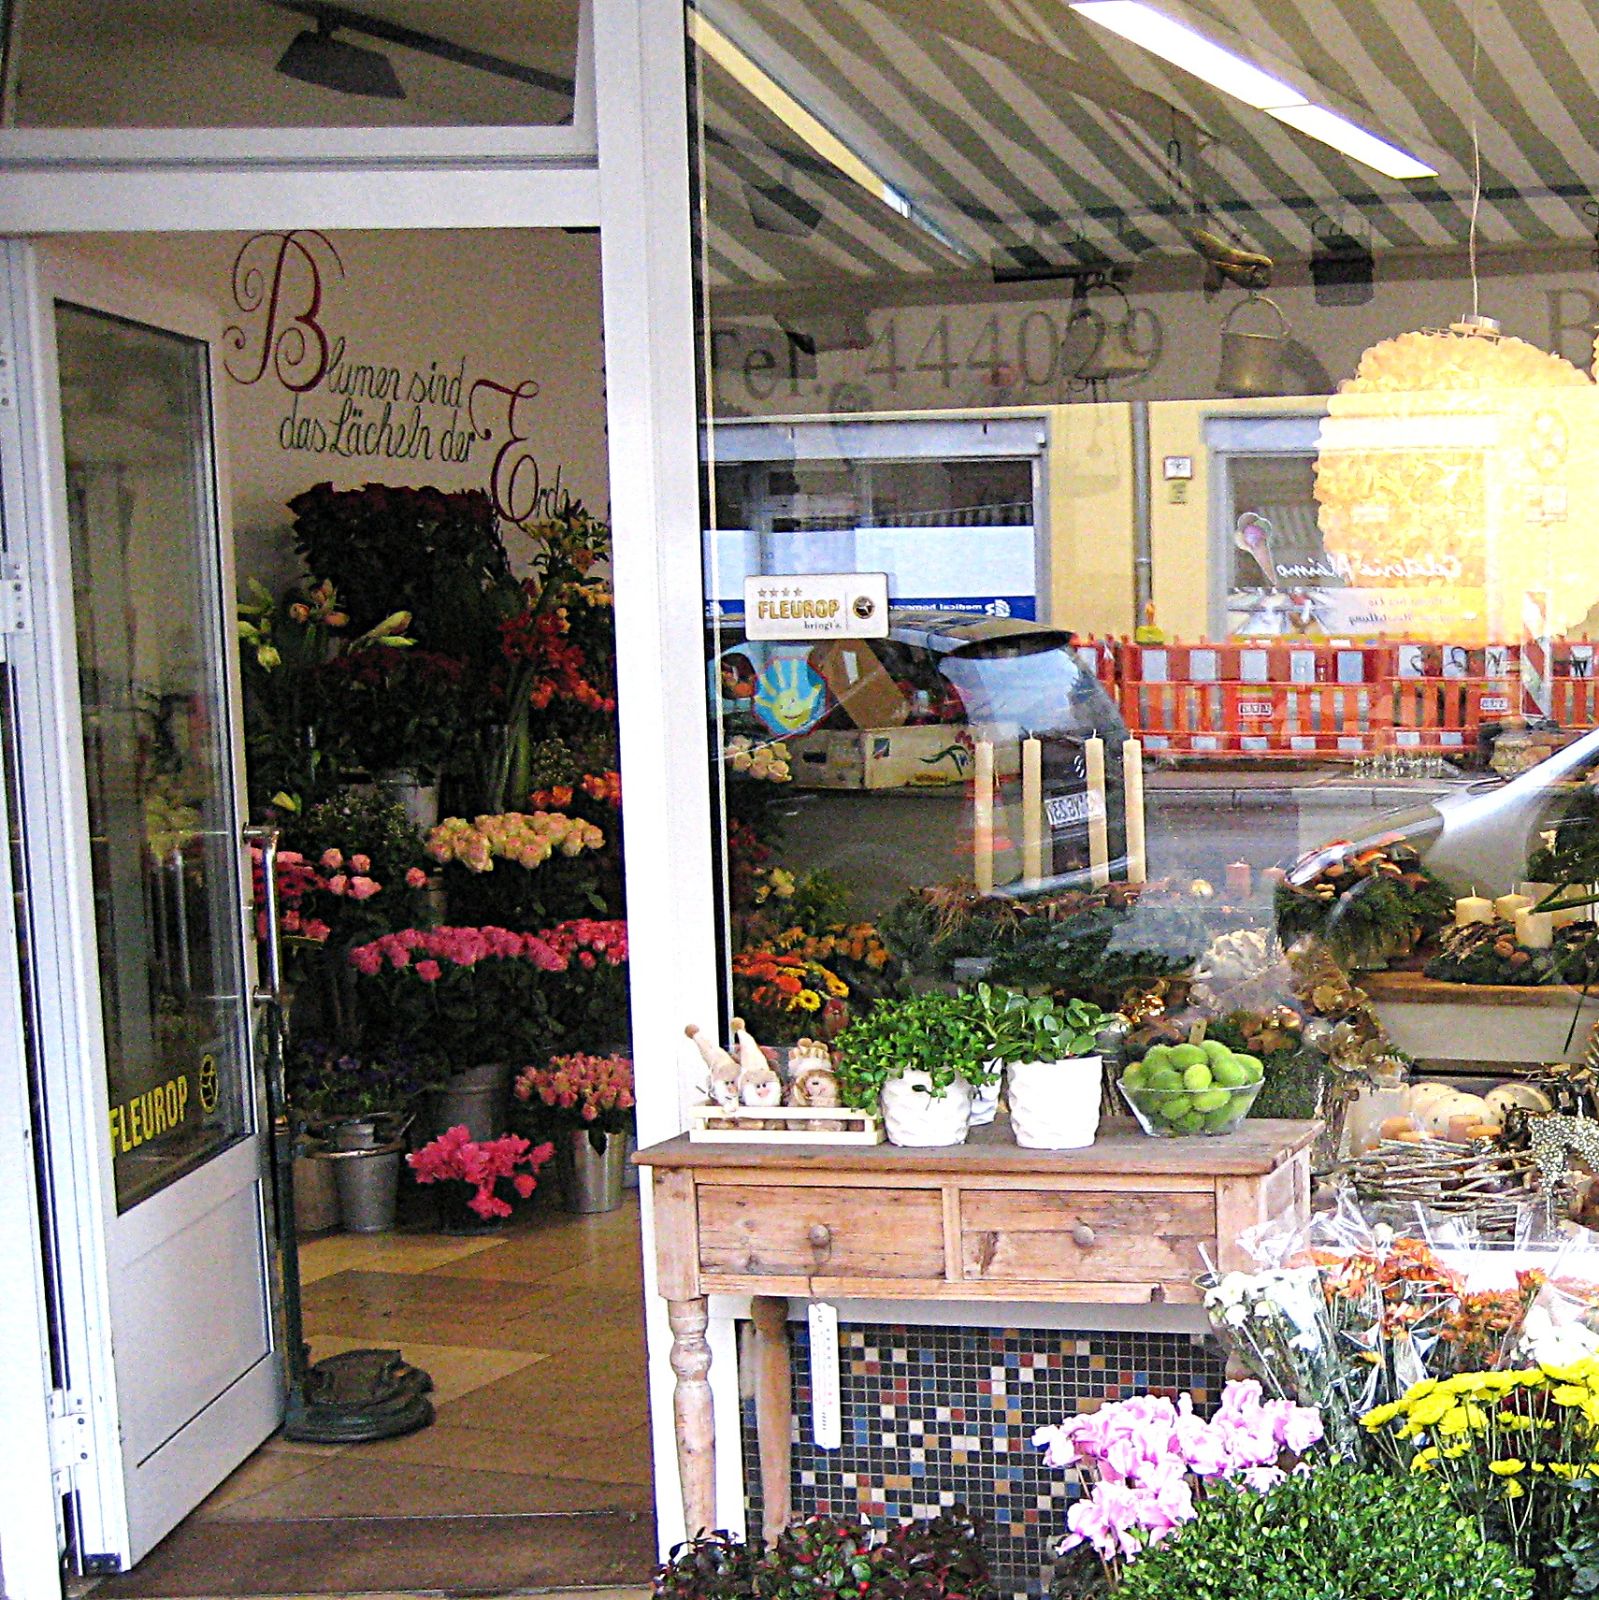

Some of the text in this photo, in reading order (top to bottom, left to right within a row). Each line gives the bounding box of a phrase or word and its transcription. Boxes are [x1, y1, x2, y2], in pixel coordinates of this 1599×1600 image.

[222, 230, 466, 408] Blumen sind
[865, 306, 1164, 389] 444029
[279, 392, 328, 452] das
[329, 397, 434, 460] Lächeln
[440, 409, 476, 463] der
[758, 599, 840, 620] FLEUROP
[109, 1075, 188, 1159] FLEUROP
